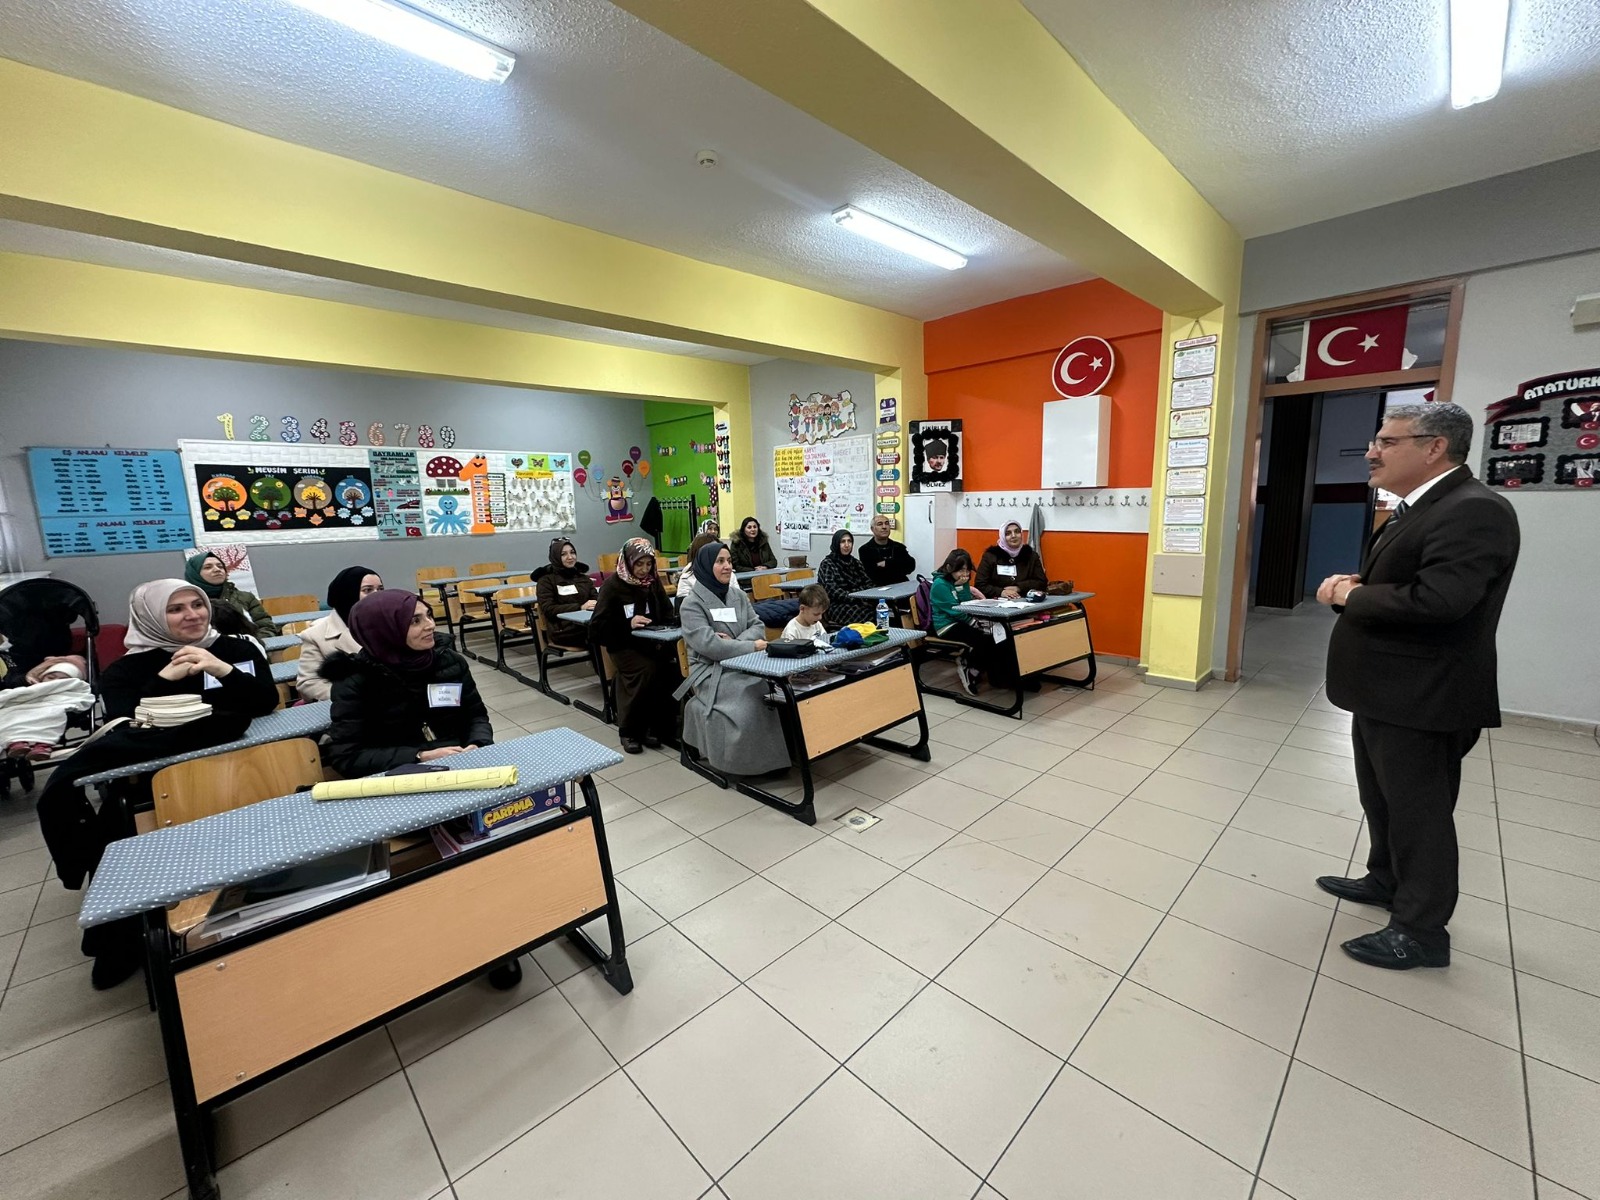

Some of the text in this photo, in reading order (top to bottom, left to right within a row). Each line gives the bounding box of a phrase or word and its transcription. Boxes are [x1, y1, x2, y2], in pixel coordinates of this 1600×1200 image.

[217, 412, 456, 449] 1 2 3 4 5 6 7 8 9
[254, 466, 288, 475] MEVSİM
[484, 797, 533, 827] ÇARPMA
